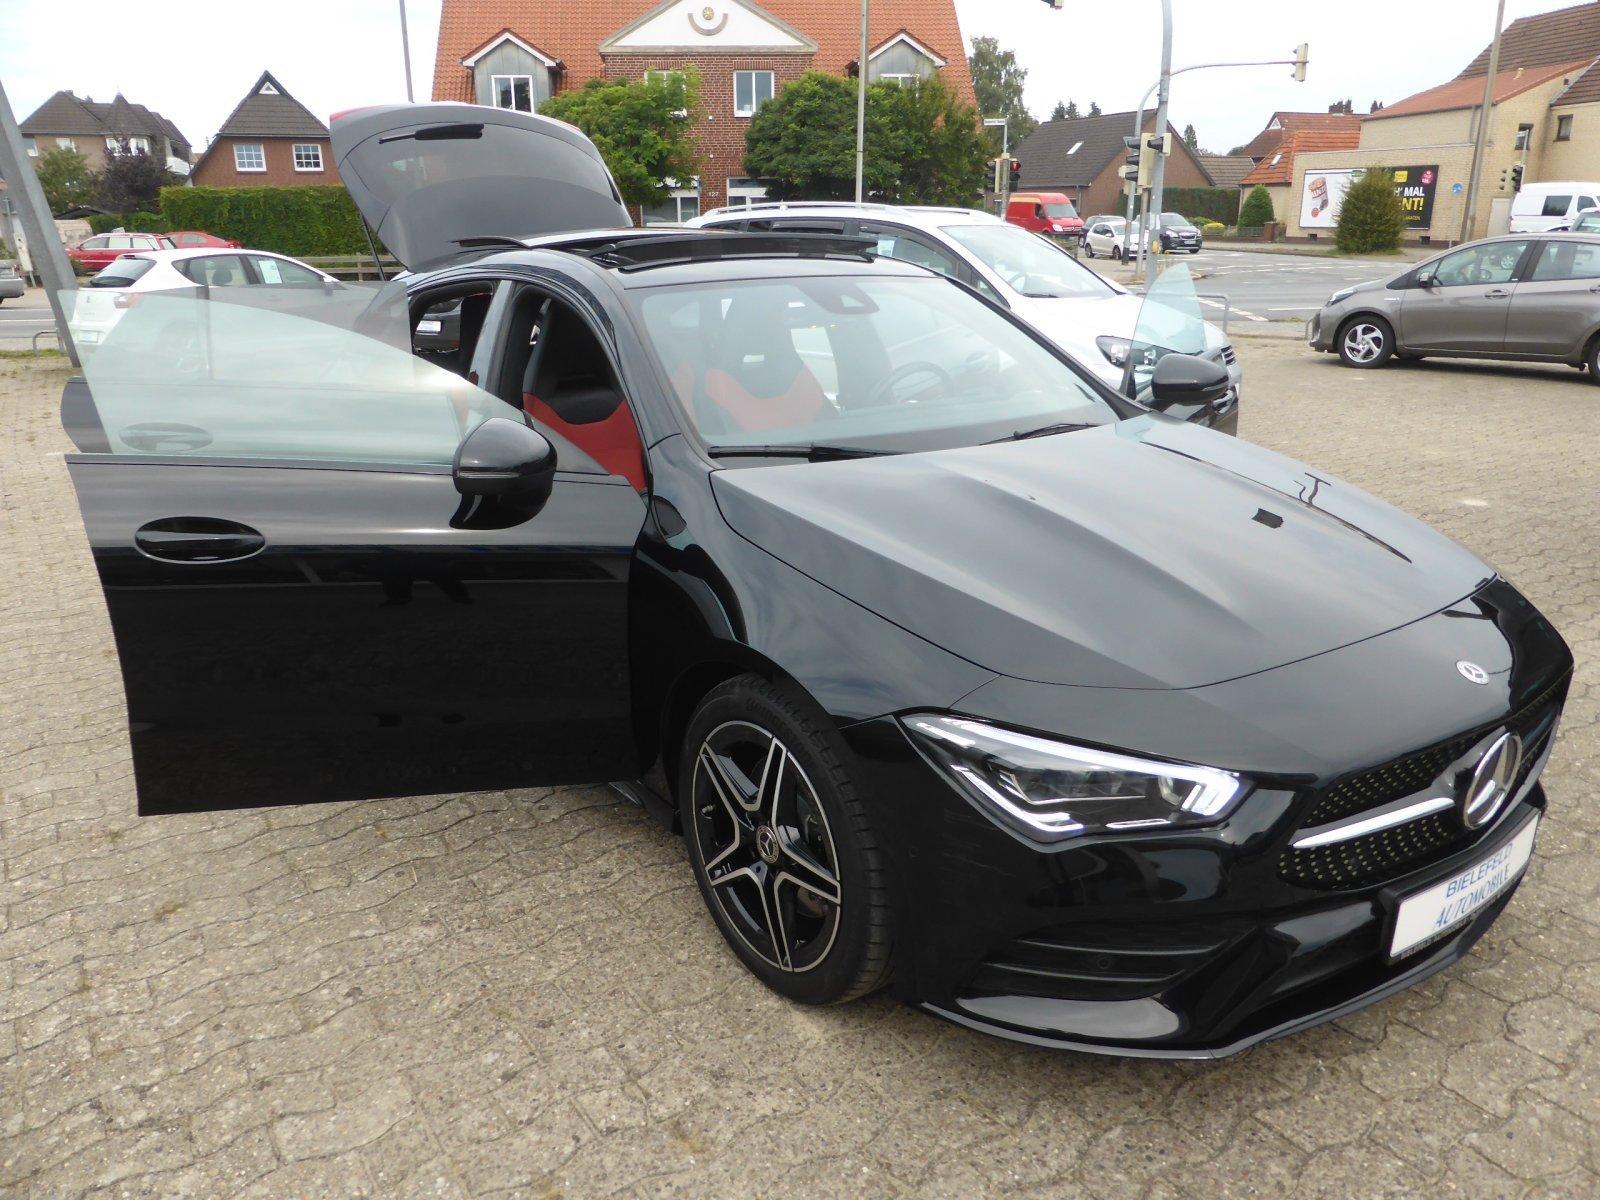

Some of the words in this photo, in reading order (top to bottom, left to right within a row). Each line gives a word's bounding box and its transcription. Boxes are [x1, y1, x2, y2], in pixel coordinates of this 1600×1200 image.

[1403, 186, 1425, 197] MAL
[1435, 862, 1510, 928] AUTOMOBILE
[1446, 842, 1513, 898] BIELEFELD
